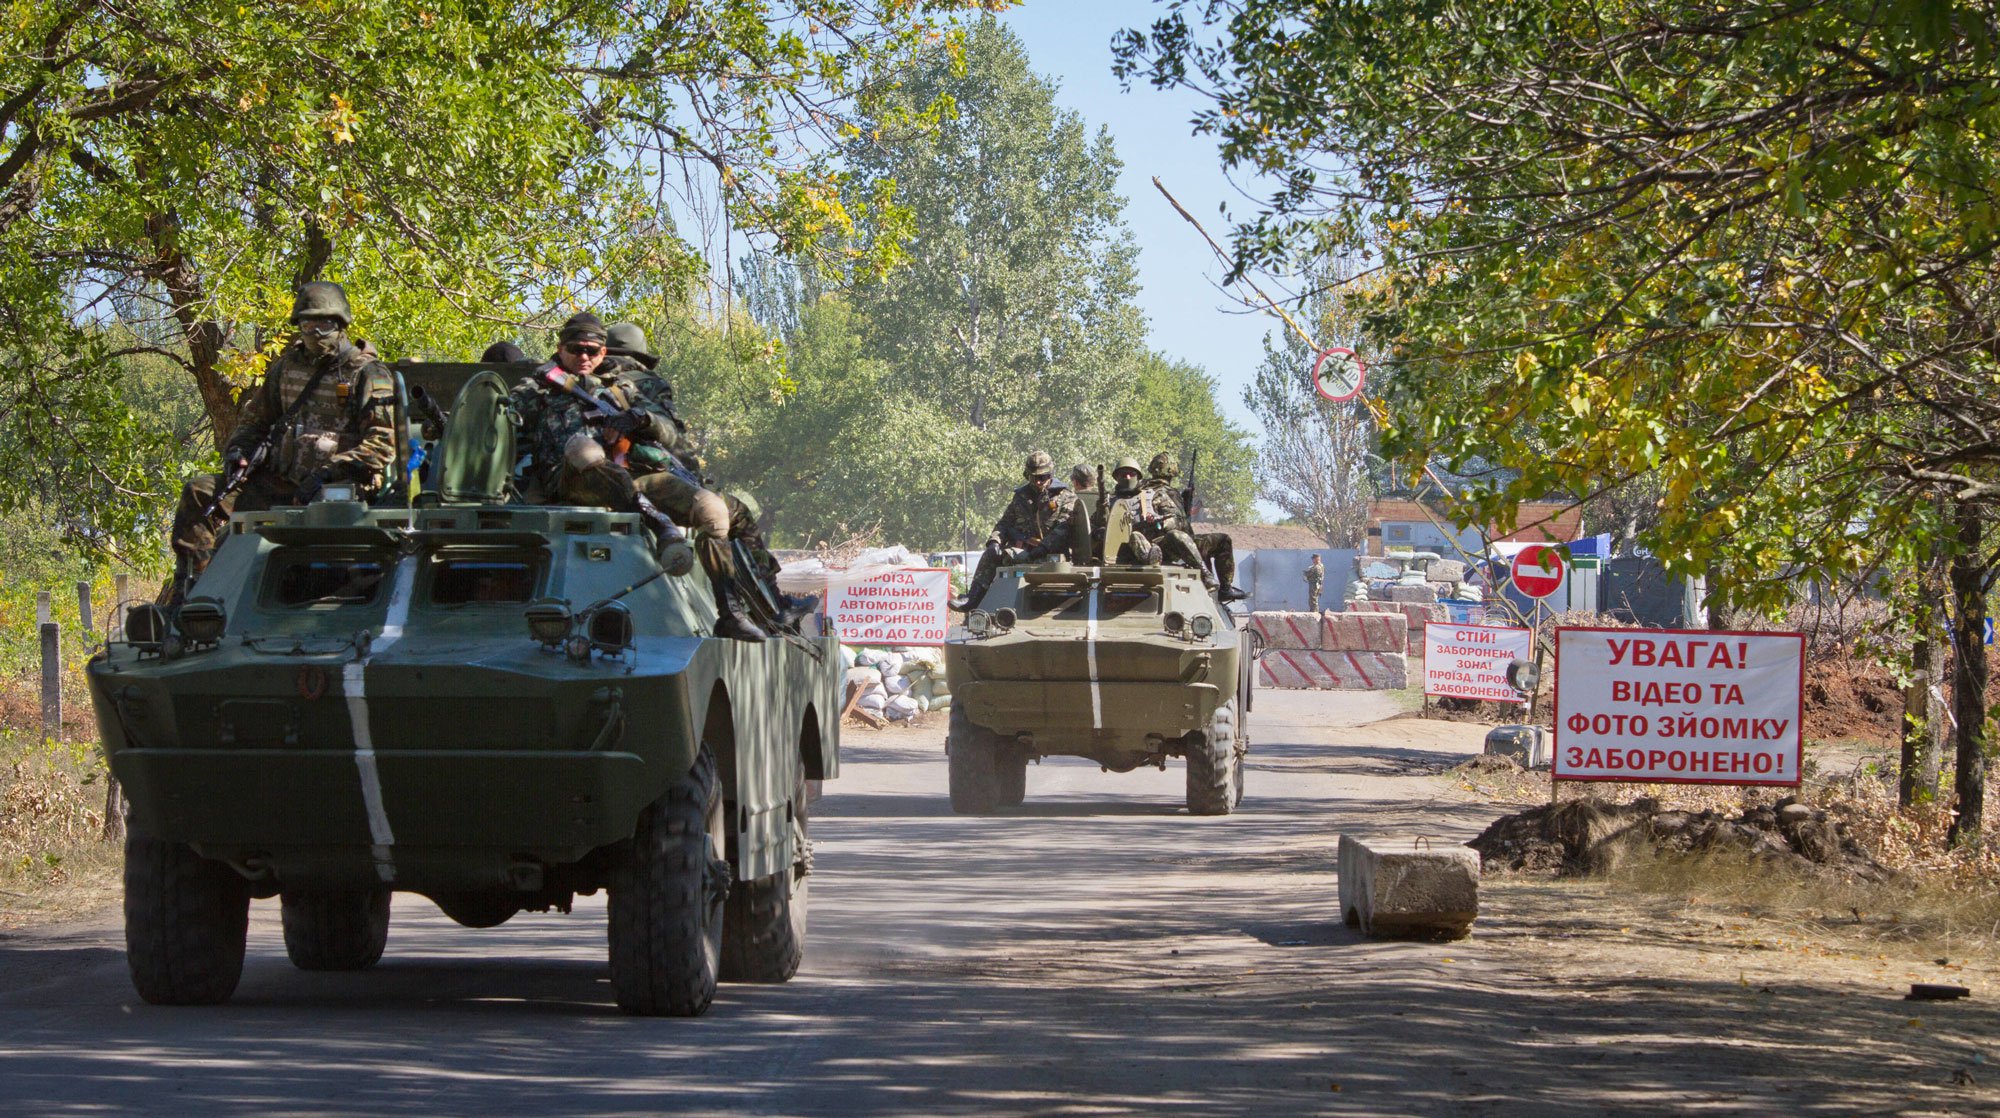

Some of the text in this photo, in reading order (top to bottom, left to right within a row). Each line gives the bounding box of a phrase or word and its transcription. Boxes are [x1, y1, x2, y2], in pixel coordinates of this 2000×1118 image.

[864, 571, 915, 585] РОЇЗД
[848, 586, 928, 598] ЦИВІЛЬНИХ
[840, 600, 934, 611] АВТОМОБІЛІВ
[838, 614, 935, 625] ЗАБОРОНЕНО!
[842, 628, 883, 639] 19.00
[886, 629, 907, 640] ДО
[913, 629, 944, 640] 7.00
[1456, 630, 1496, 644] СТІЙ!
[1437, 645, 1515, 659] ЗАБОРОНЕНА
[1607, 639, 1747, 669] УВАГА!
[1456, 660, 1492, 670] ЗОНА!
[1429, 670, 1508, 685] ПРОЇЗД, ПРОХ
[1433, 683, 1515, 698] ЗАБОРОНЕНО!
[1612, 681, 1744, 706] ВІДЕО ТА
[1567, 712, 1789, 740] ФОТО ЗЙОМКУ
[1566, 747, 1784, 774] ЗАБОРОНЕНО!
